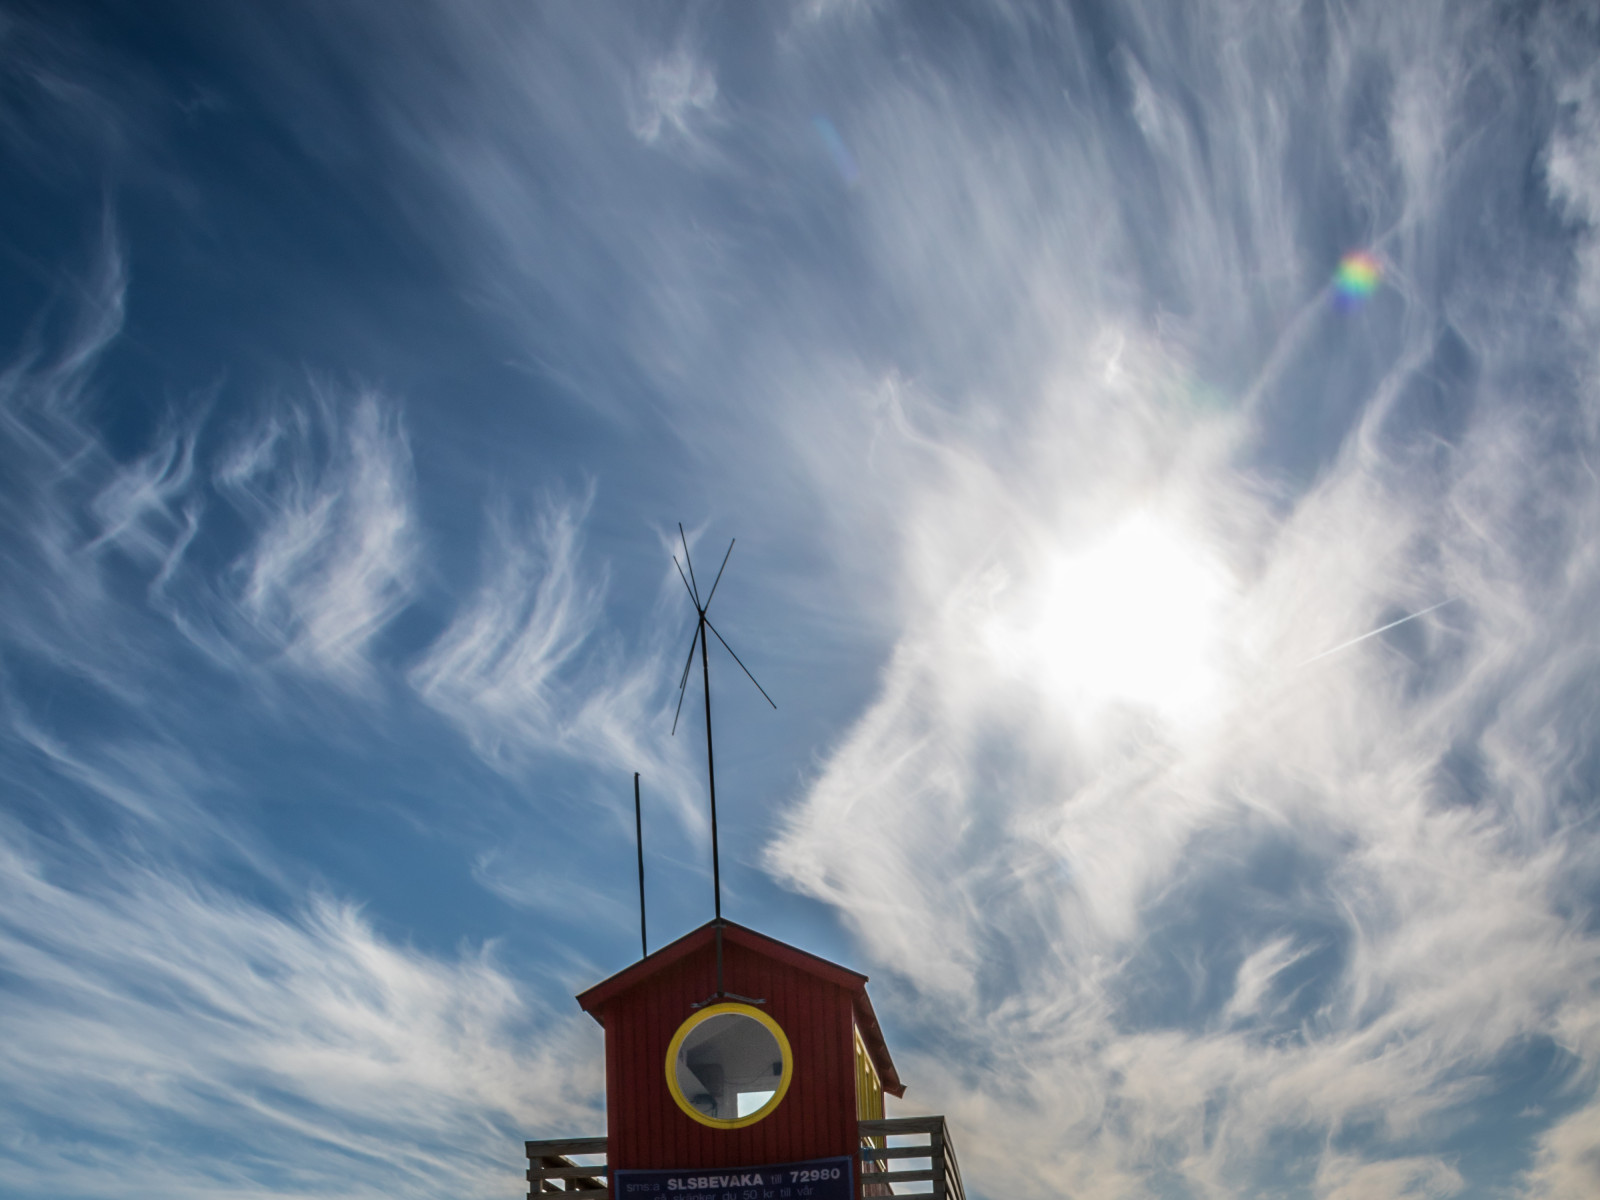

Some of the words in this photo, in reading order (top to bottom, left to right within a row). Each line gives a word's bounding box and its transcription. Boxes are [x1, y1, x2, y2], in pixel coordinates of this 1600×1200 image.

[626, 1182, 660, 1193] sms:a
[667, 1173, 764, 1191] SLSBEVAKA
[770, 1174, 782, 1186] till
[790, 1168, 841, 1184] 72980
[743, 1190, 758, 1200] 50
[763, 1187, 774, 1199] kr
[780, 1186, 791, 1198] till
[797, 1184, 814, 1197] vår
